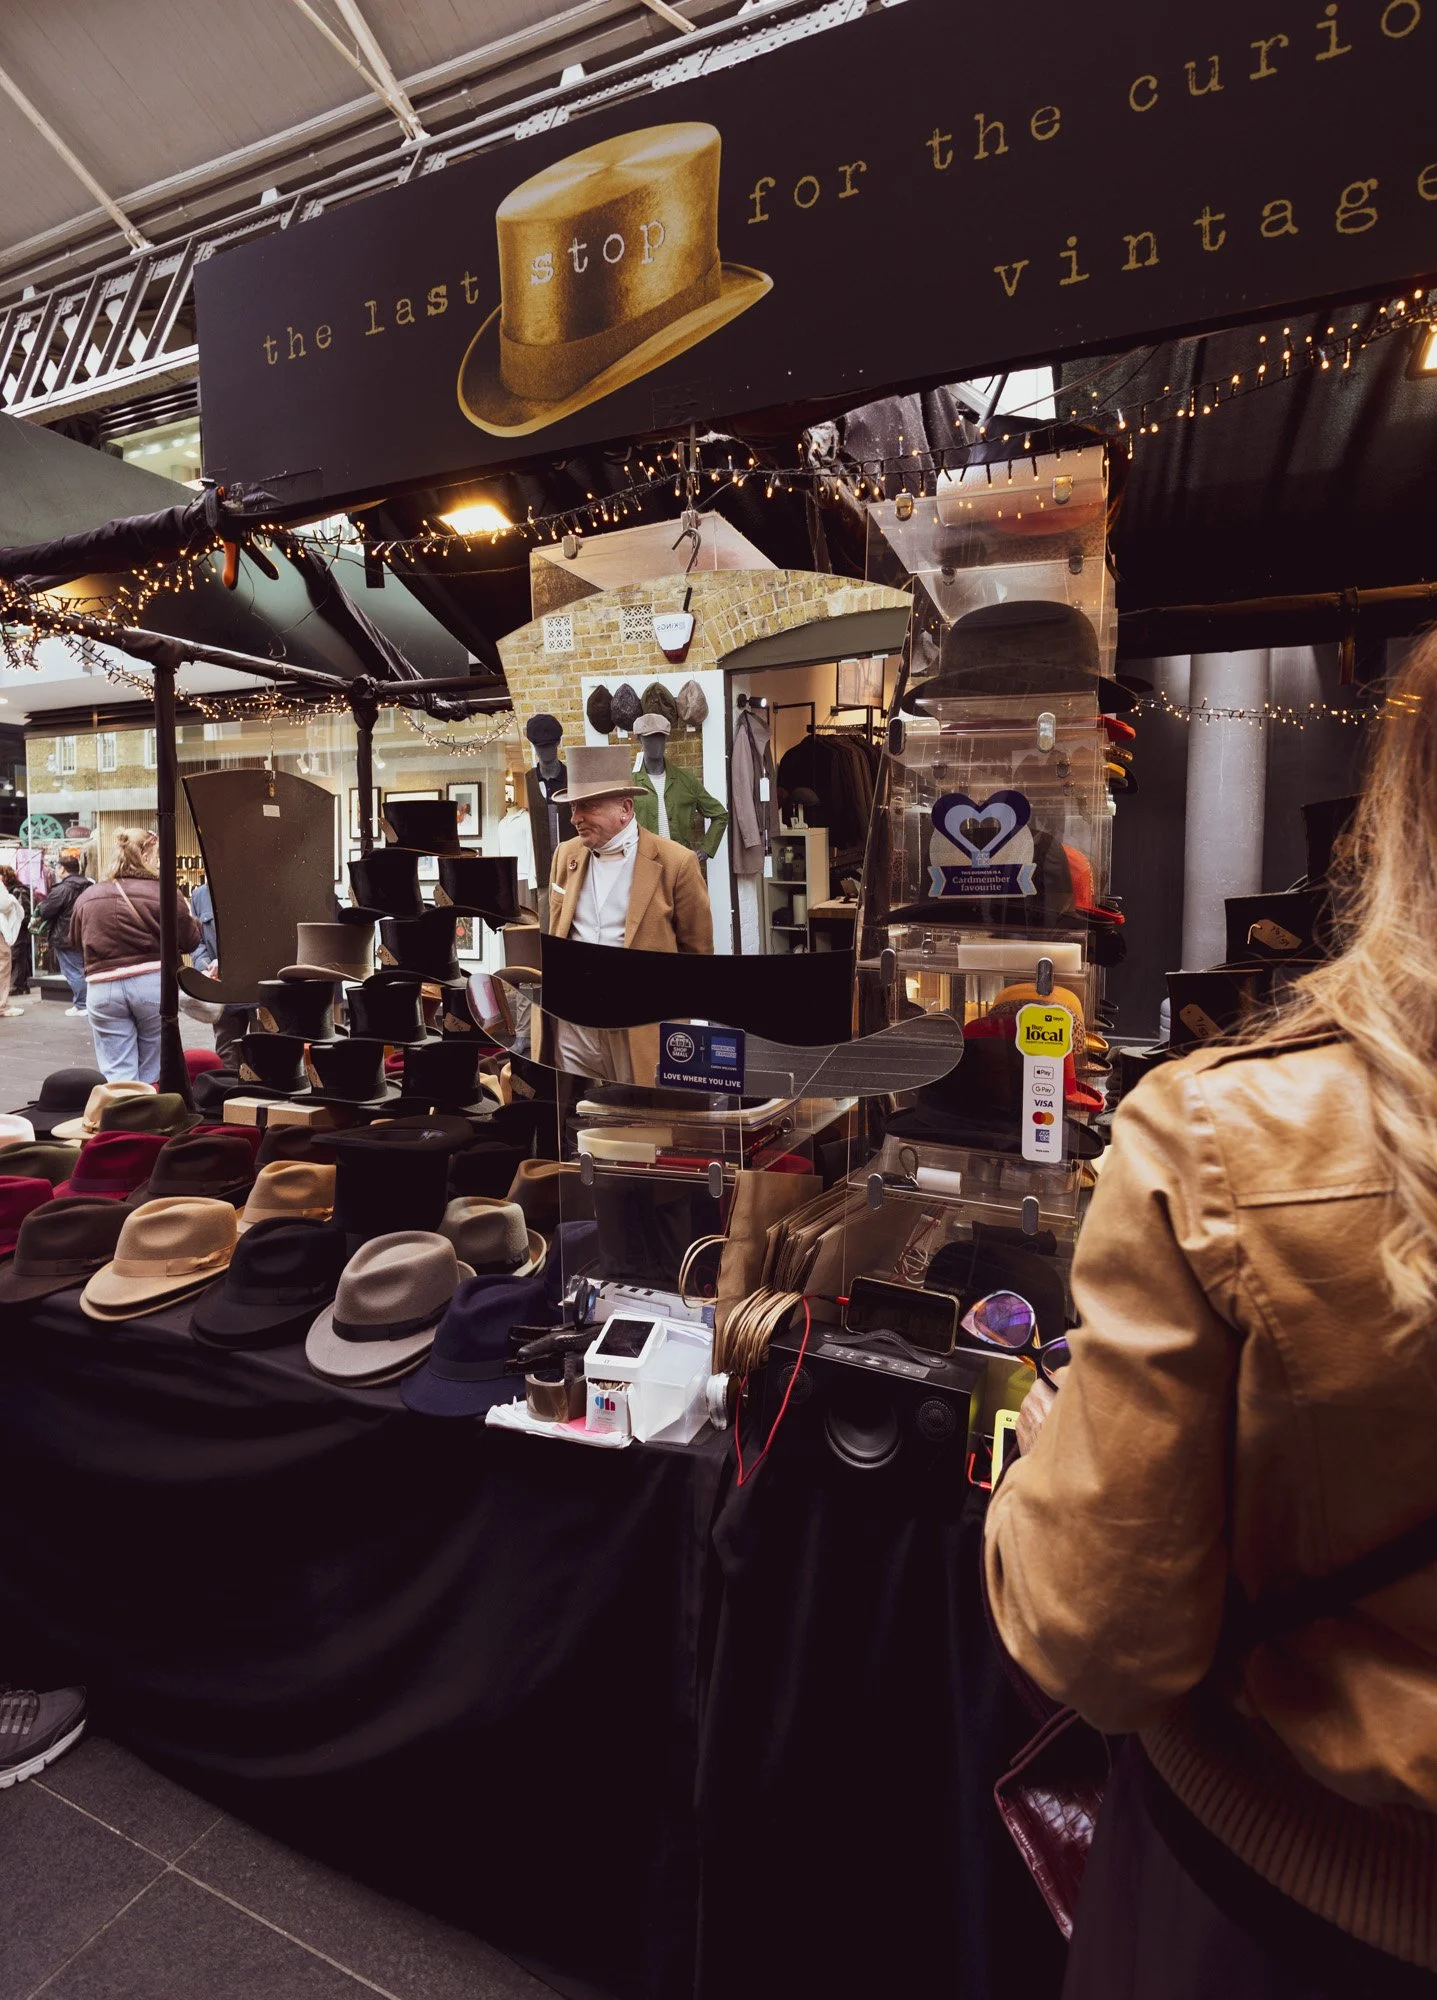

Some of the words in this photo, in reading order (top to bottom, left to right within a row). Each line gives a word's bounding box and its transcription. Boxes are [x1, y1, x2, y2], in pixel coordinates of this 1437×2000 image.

[263, 319, 333, 366] the
[364, 271, 480, 337] last
[530, 219, 666, 287] stop
[747, 159, 868, 225] for
[927, 106, 1062, 170] the
[1129, 0, 1422, 113] curio
[993, 164, 1437, 298] vintage
[952, 876, 1010, 884] Cardmember
[961, 883, 1001, 891] favourite
[1025, 1026, 1063, 1042] local
[1041, 1069, 1051, 1077] Pay
[663, 1072, 681, 1080] LOVE
[682, 1074, 707, 1084] WHERE
[708, 1077, 724, 1086] YOU
[725, 1080, 741, 1088] LIVE
[1034, 1099, 1054, 1108] VISA
